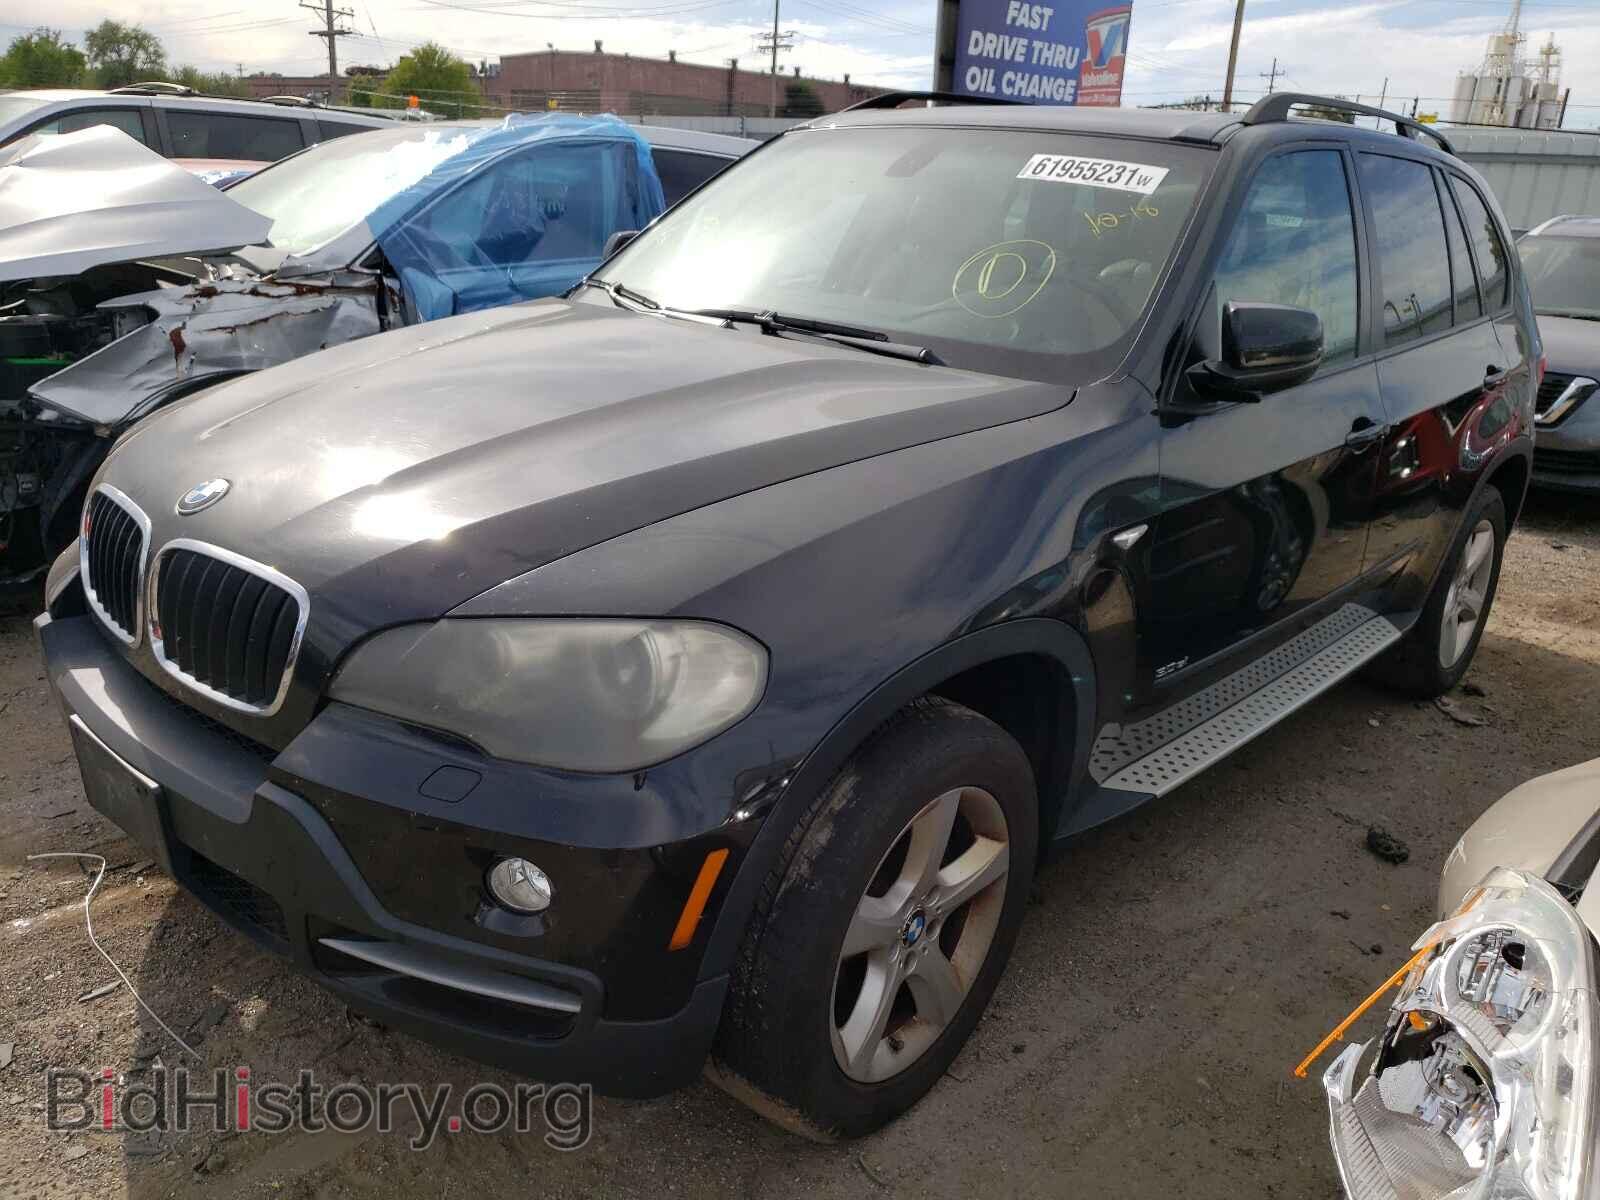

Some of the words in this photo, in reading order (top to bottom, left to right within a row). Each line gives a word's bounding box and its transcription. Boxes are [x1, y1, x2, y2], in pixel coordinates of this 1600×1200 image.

[1006, 0, 1054, 31] FAST
[967, 30, 1028, 62] DRIVE
[1031, 40, 1080, 70] THRU
[965, 66, 996, 94] OIL
[1001, 71, 1077, 102] CHANGE
